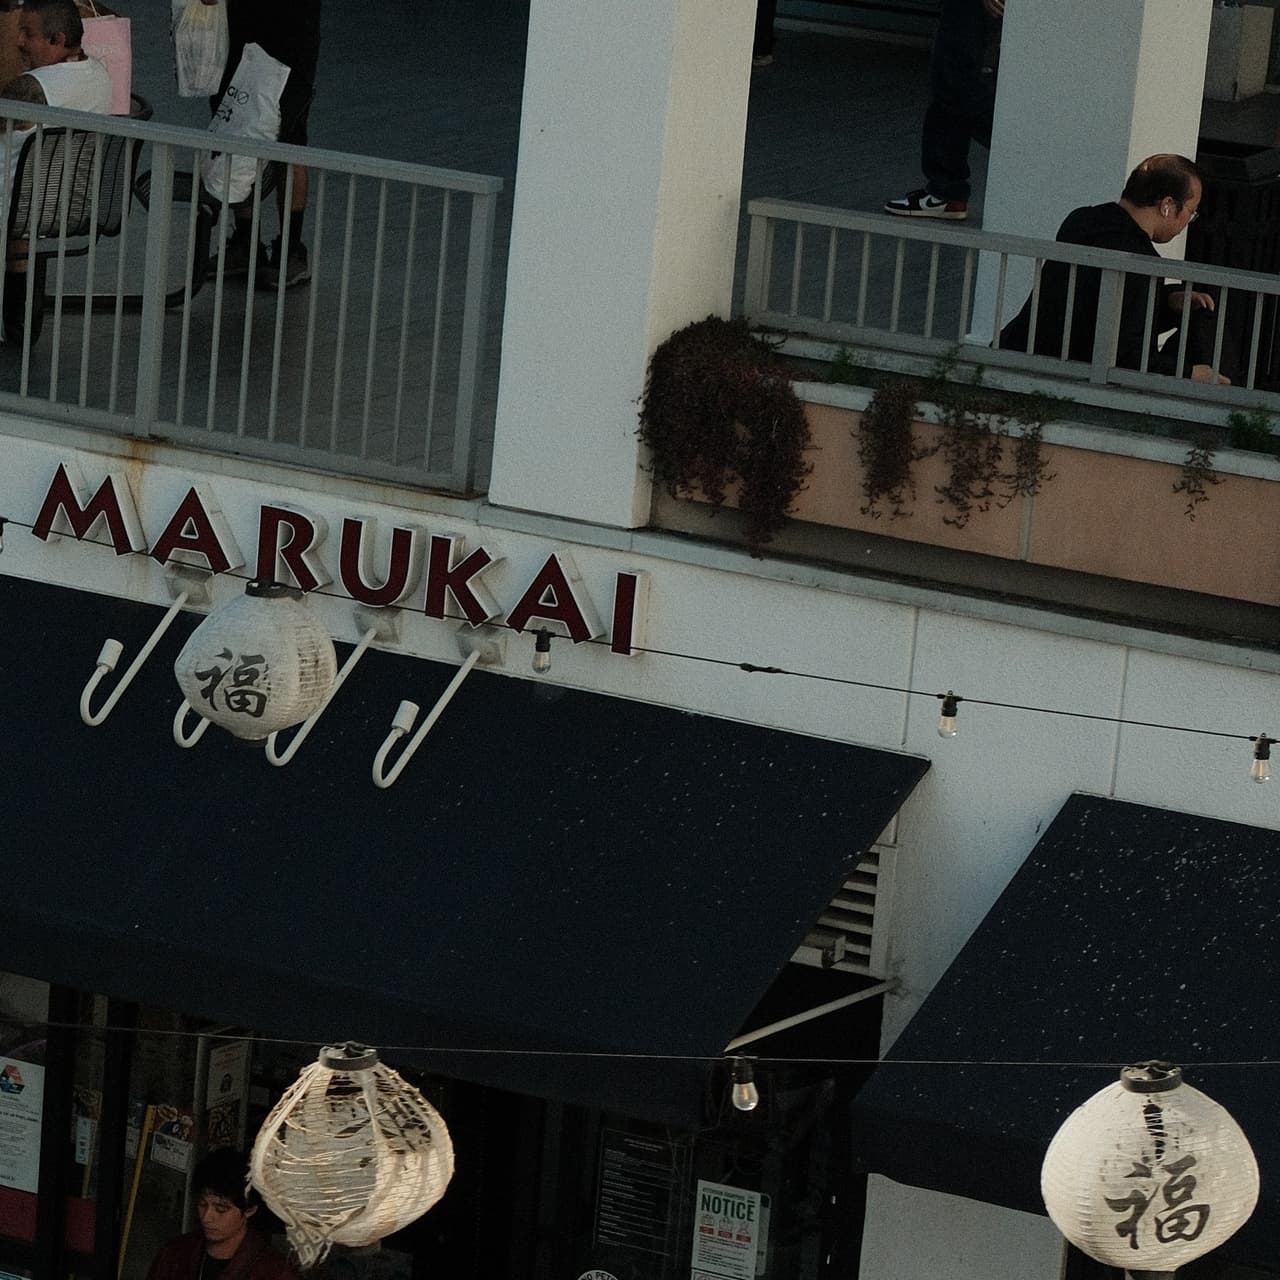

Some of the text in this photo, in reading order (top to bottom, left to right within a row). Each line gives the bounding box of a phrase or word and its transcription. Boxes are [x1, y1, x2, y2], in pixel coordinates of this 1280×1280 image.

[31, 462, 640, 656] MARUKAI
[194, 647, 268, 718] 福
[701, 1193, 756, 1222] NOTICE
[1104, 1154, 1211, 1250] 福
